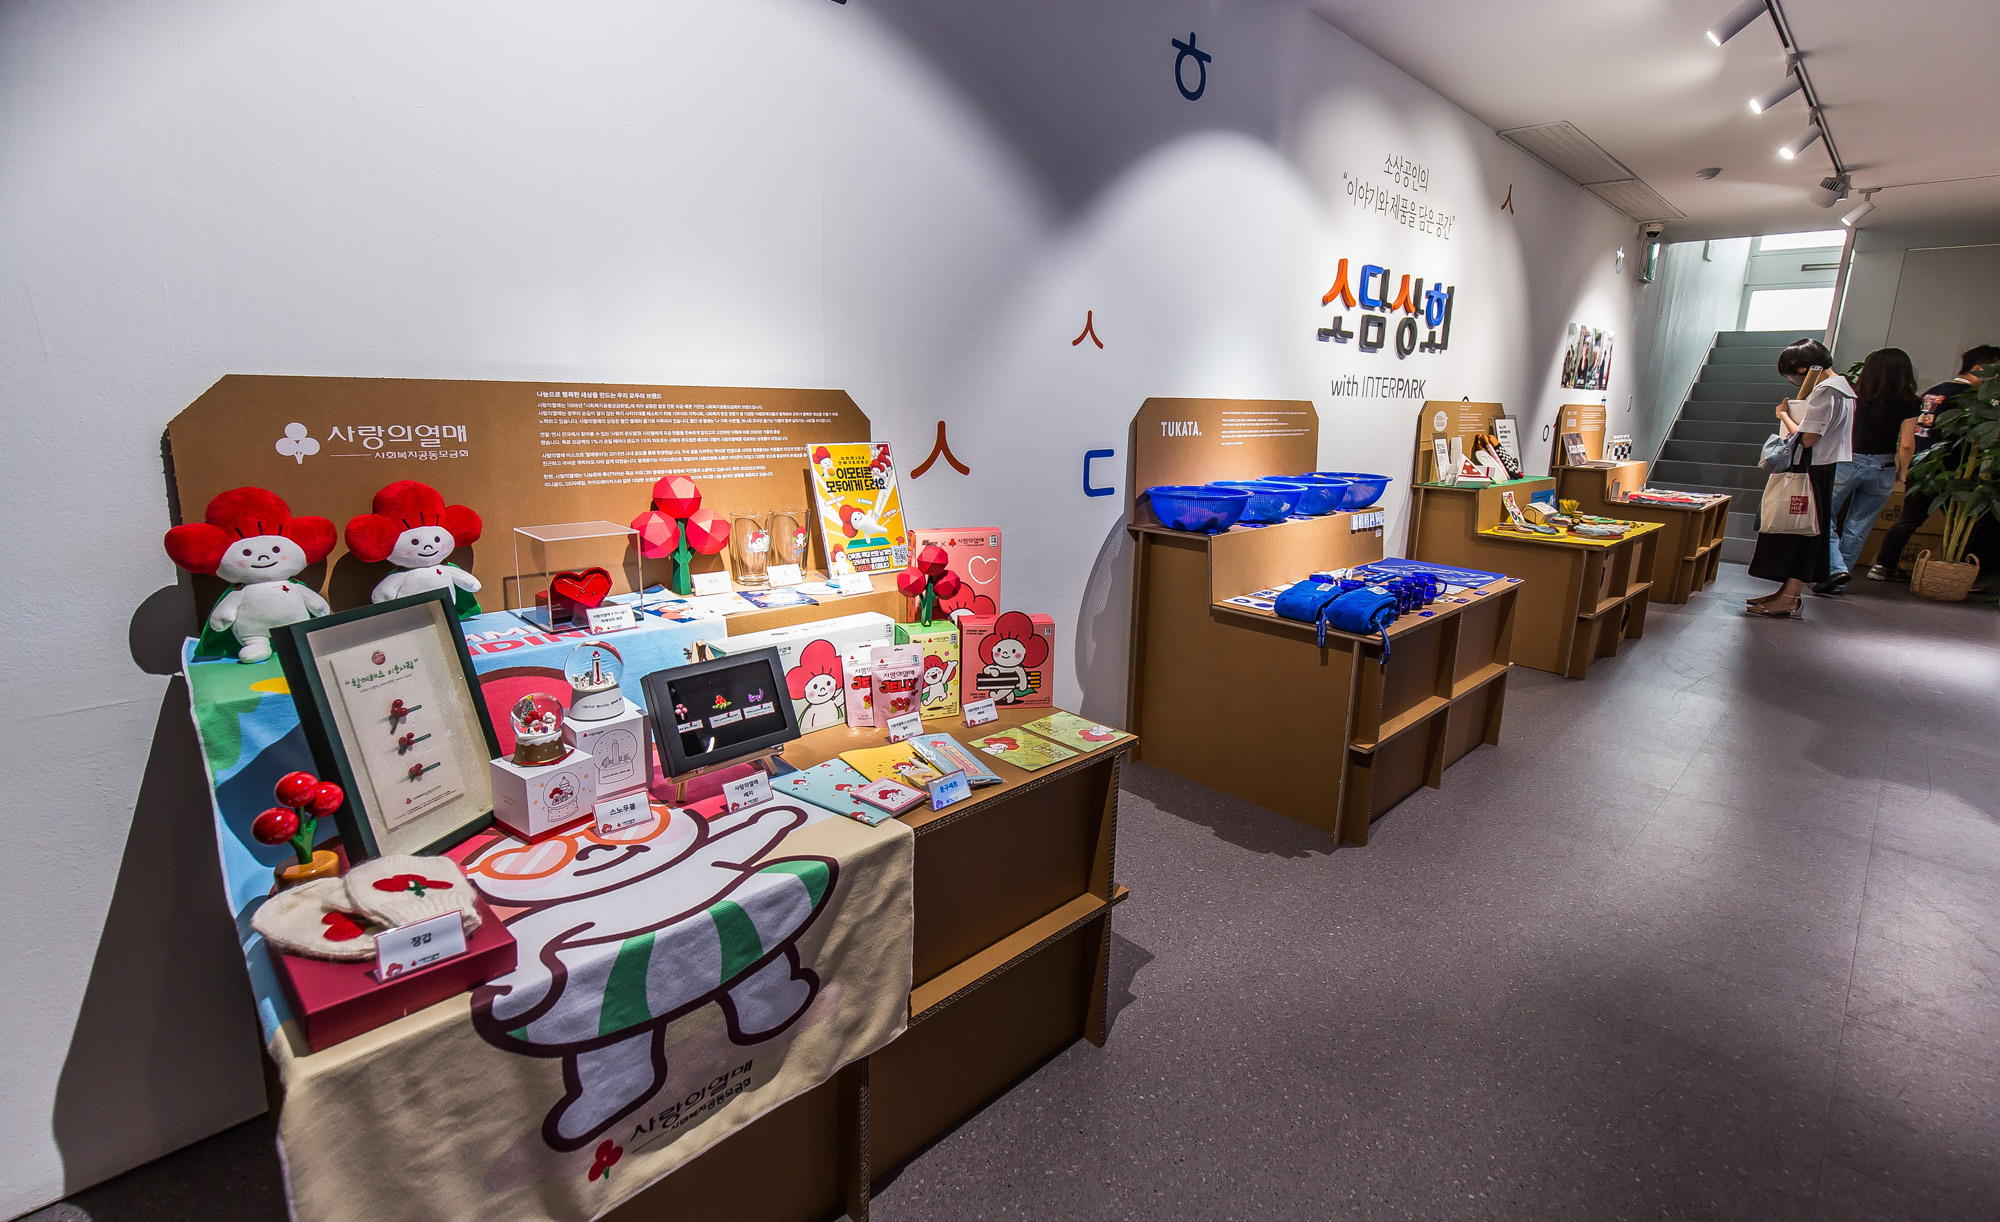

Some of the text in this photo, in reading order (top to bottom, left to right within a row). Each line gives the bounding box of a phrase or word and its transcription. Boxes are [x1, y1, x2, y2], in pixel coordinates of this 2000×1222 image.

[1383, 153, 1429, 193] 소상공인의
[1390, 194, 1417, 228] 제품을
[1419, 205, 1434, 234] 담은
[1317, 258, 1455, 356] 소담상회
[1332, 374, 1426, 399] with INTERPARK
[327, 424, 468, 450] 사랑의열매
[374, 450, 469, 460] 사회복지공동모금회
[836, 466, 872, 480] 이모티콘
[826, 478, 886, 493] 모두에게 드려요
[884, 670, 914, 679] 사랑의열매
[879, 678, 919, 694] JELLY
[610, 802, 636, 816] 스노우볼
[410, 932, 432, 948] 장갑
[629, 1059, 753, 1142] 사랑의열매
